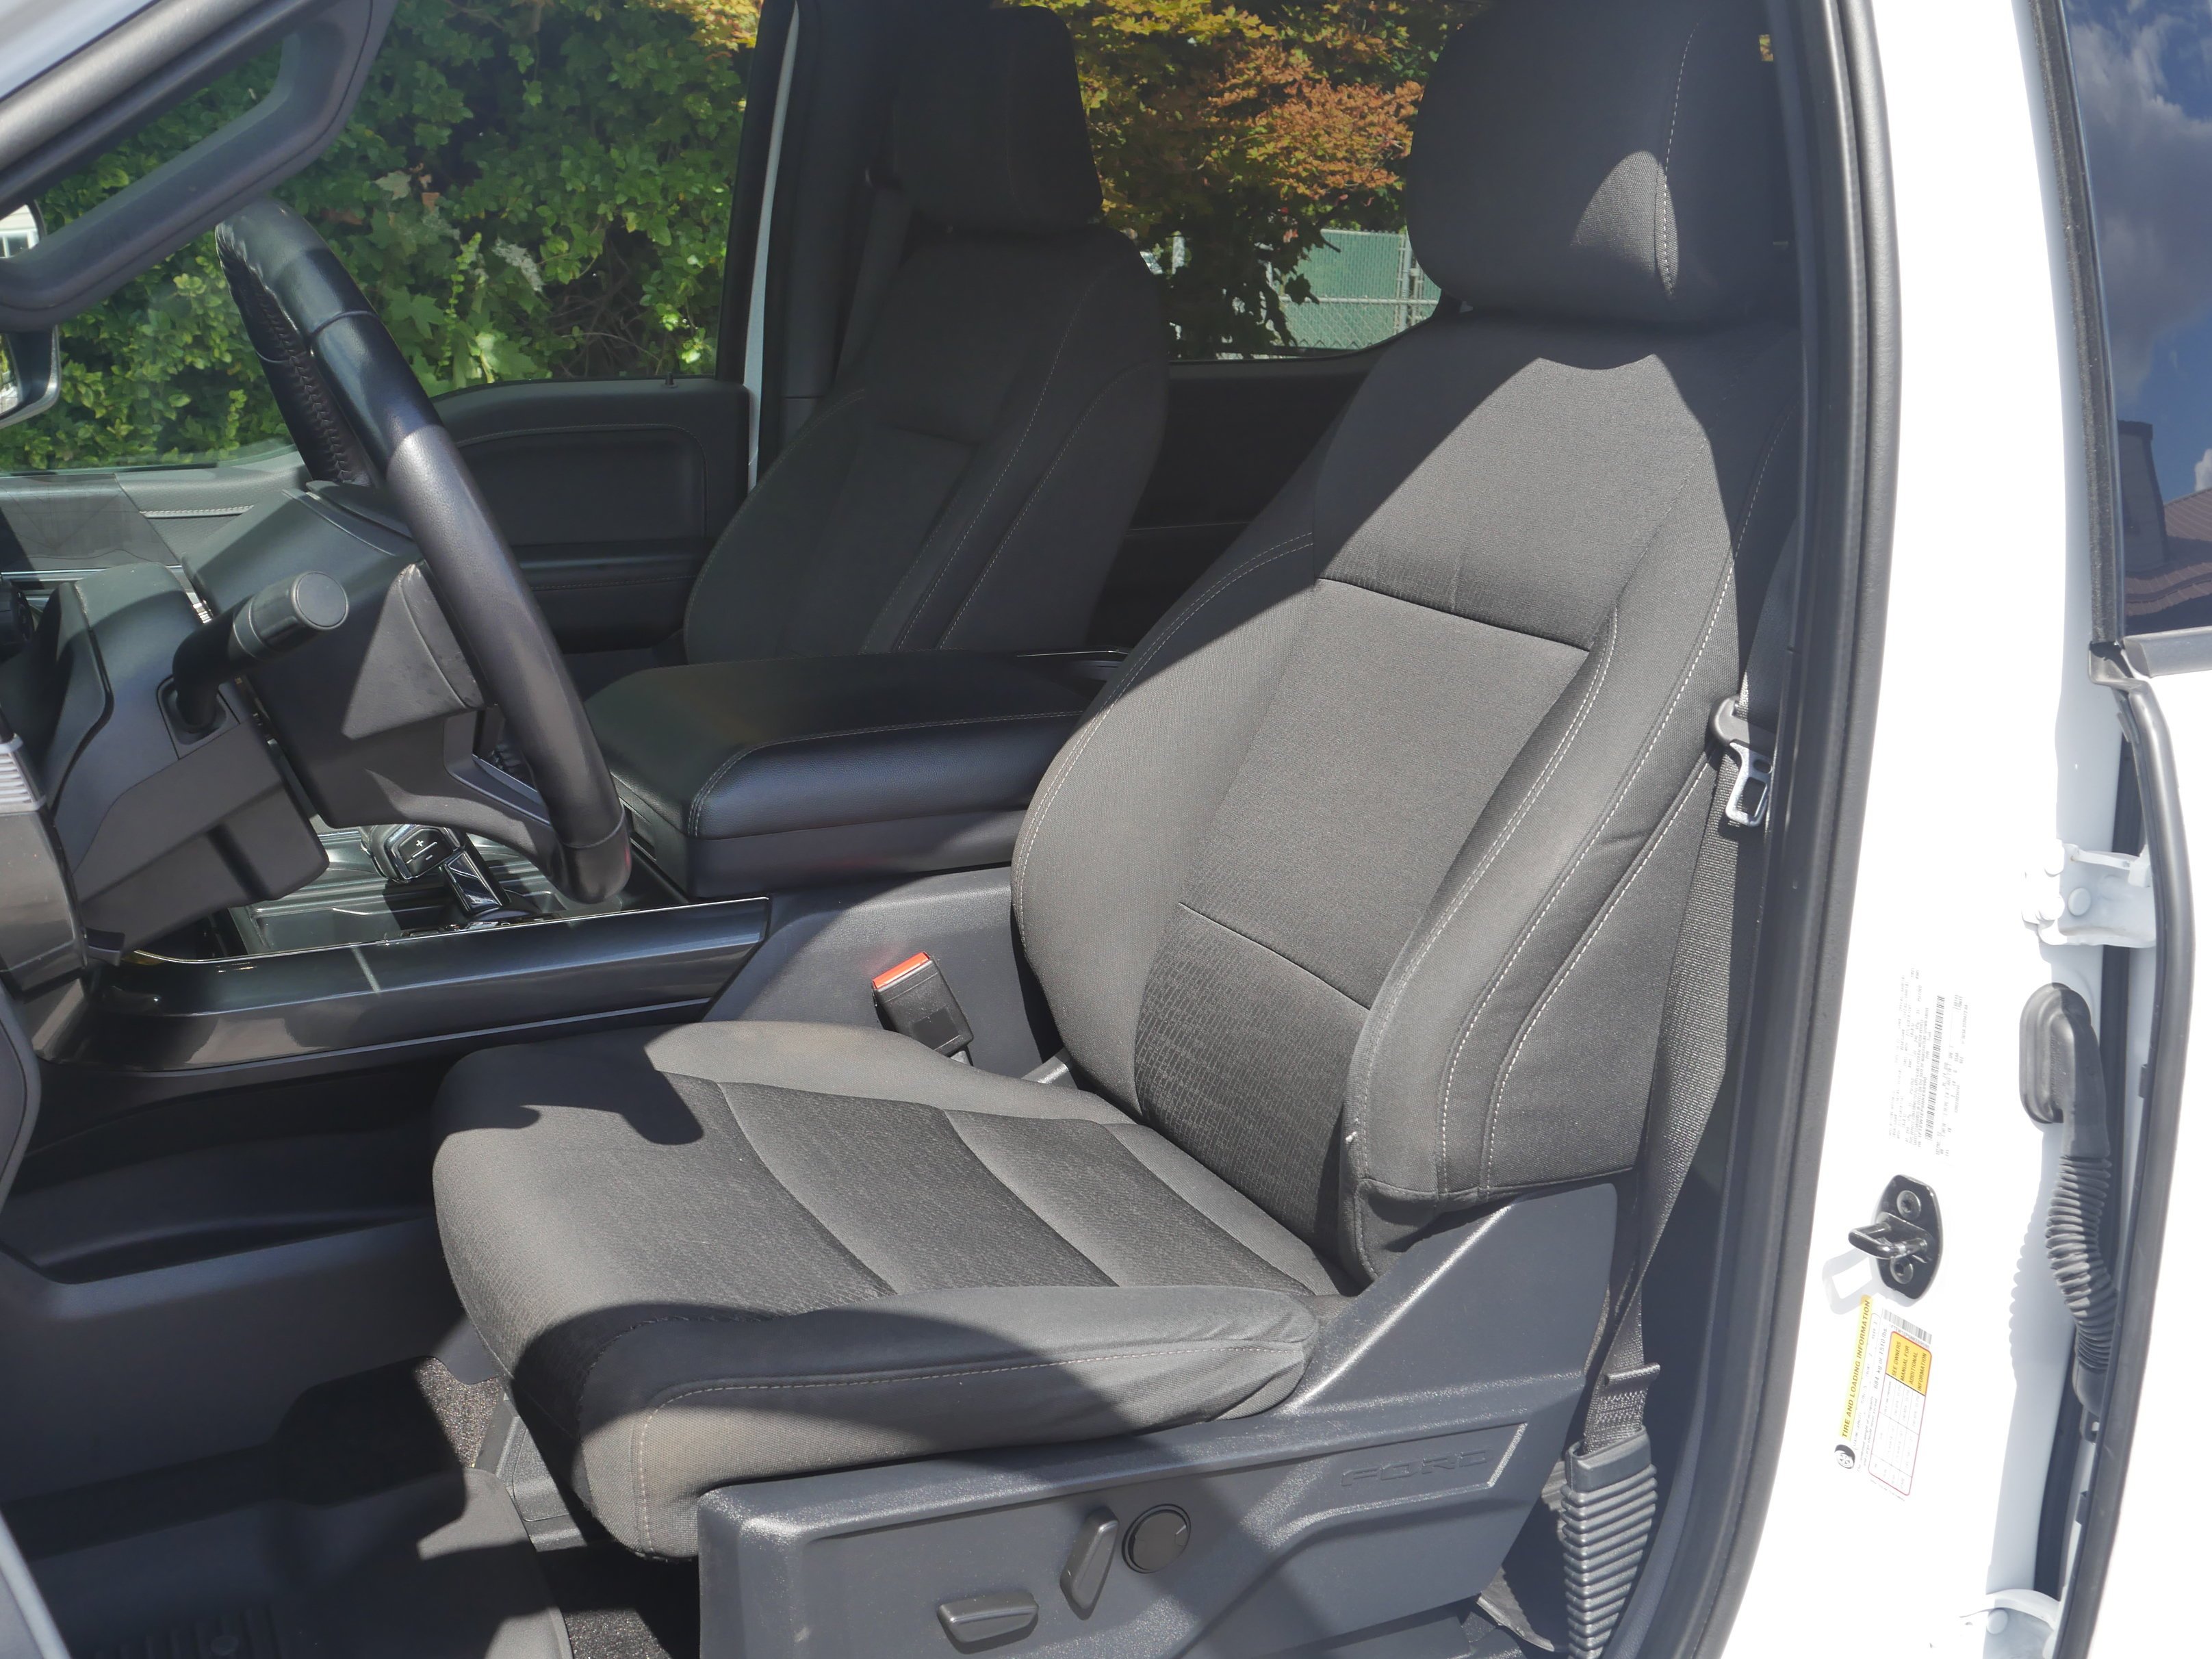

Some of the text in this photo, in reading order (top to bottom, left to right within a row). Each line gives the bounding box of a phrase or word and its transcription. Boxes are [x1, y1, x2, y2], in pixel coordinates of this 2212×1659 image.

[1878, 1339, 1886, 1354] 1510
[1893, 1341, 1901, 1365] OWNERS
[1842, 1419, 1850, 1437] TIRE
[1850, 1361, 1860, 1398] LOADING
[1857, 1300, 1870, 1359] INFORMATION
[1900, 1359, 1908, 1381] MANUAL
[1909, 1352, 1918, 1385] ADDITIONAL
[1918, 1353, 1927, 1391] INFORMATION
[1341, 1447, 1495, 1487] FORD
